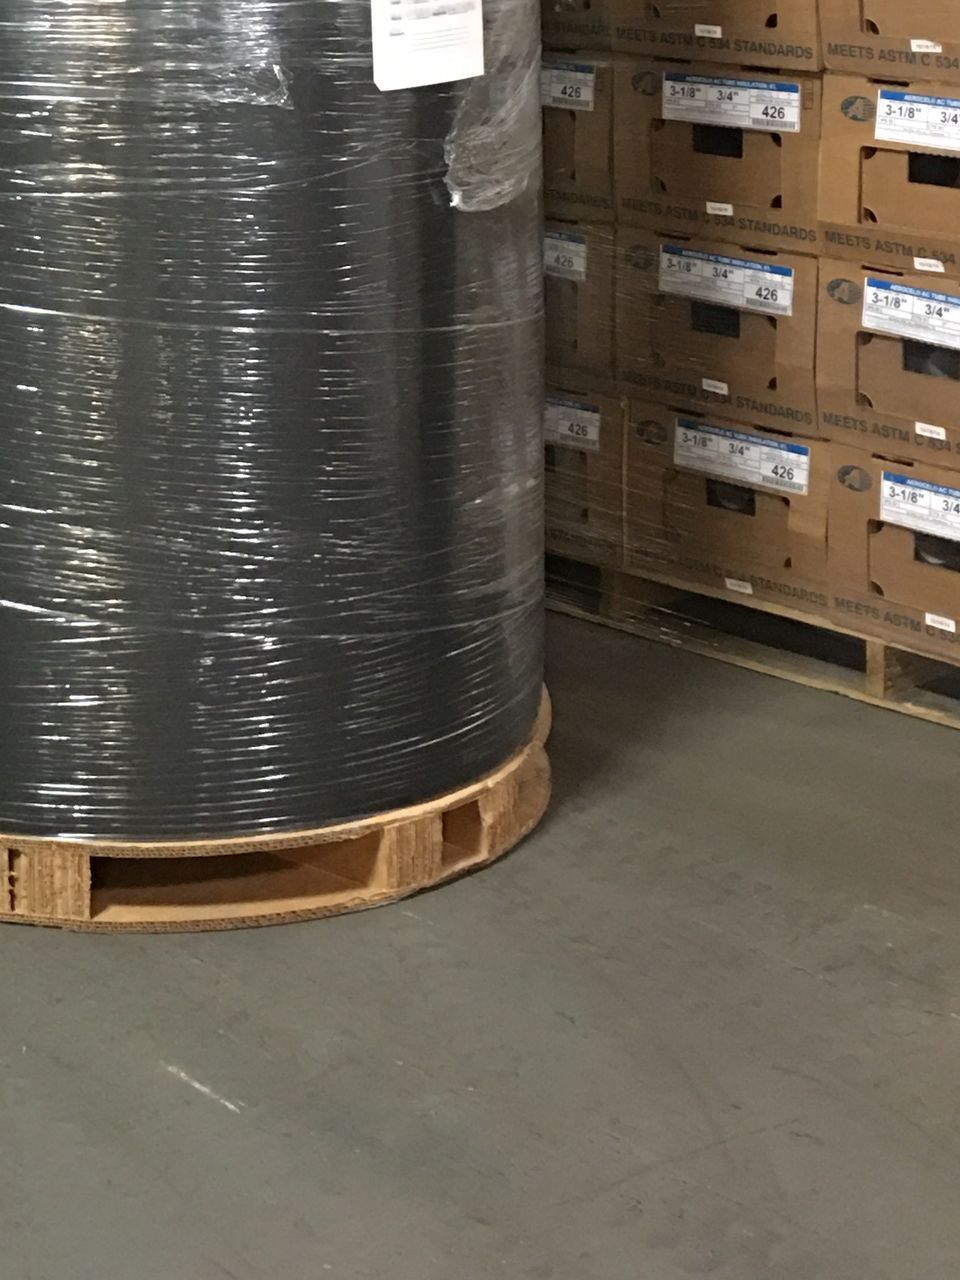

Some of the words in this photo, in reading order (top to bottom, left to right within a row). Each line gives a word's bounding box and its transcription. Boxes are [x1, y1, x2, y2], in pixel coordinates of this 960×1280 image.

[660, 32, 695, 47] ASTM
[734, 38, 813, 60] STANDARDS
[828, 43, 874, 60] MEETS
[878, 49, 917, 64] ASTM
[921, 52, 931, 66] C
[936, 55, 960, 69] 534
[561, 86, 581, 98] 426
[670, 86, 701, 98] 3-1/8"
[716, 89, 739, 102] 3/4"
[762, 106, 785, 119] 426
[885, 104, 922, 119] 3-1/8"
[738, 218, 817, 242] STANDARDS
[824, 230, 871, 250] MEETS
[875, 239, 914, 255] ASTM
[917, 245, 927, 258] C
[932, 249, 956, 265] 534
[553, 255, 574, 268] 426
[712, 267, 734, 280] 3/4"
[755, 287, 778, 302] 426
[871, 292, 907, 309] 3-1/8"
[924, 303, 950, 318] 3/4"
[736, 396, 813, 425] STANDARDS
[568, 423, 588, 437] 426
[823, 411, 868, 433] MEETS
[872, 422, 909, 441] ASTM
[913, 430, 923, 446] C
[728, 442, 751, 456] 3/4"
[771, 464, 794, 481] 426
[889, 485, 924, 504] 3-1/8"
[834, 596, 879, 620] MEETS
[884, 610, 921, 633] ASTM
